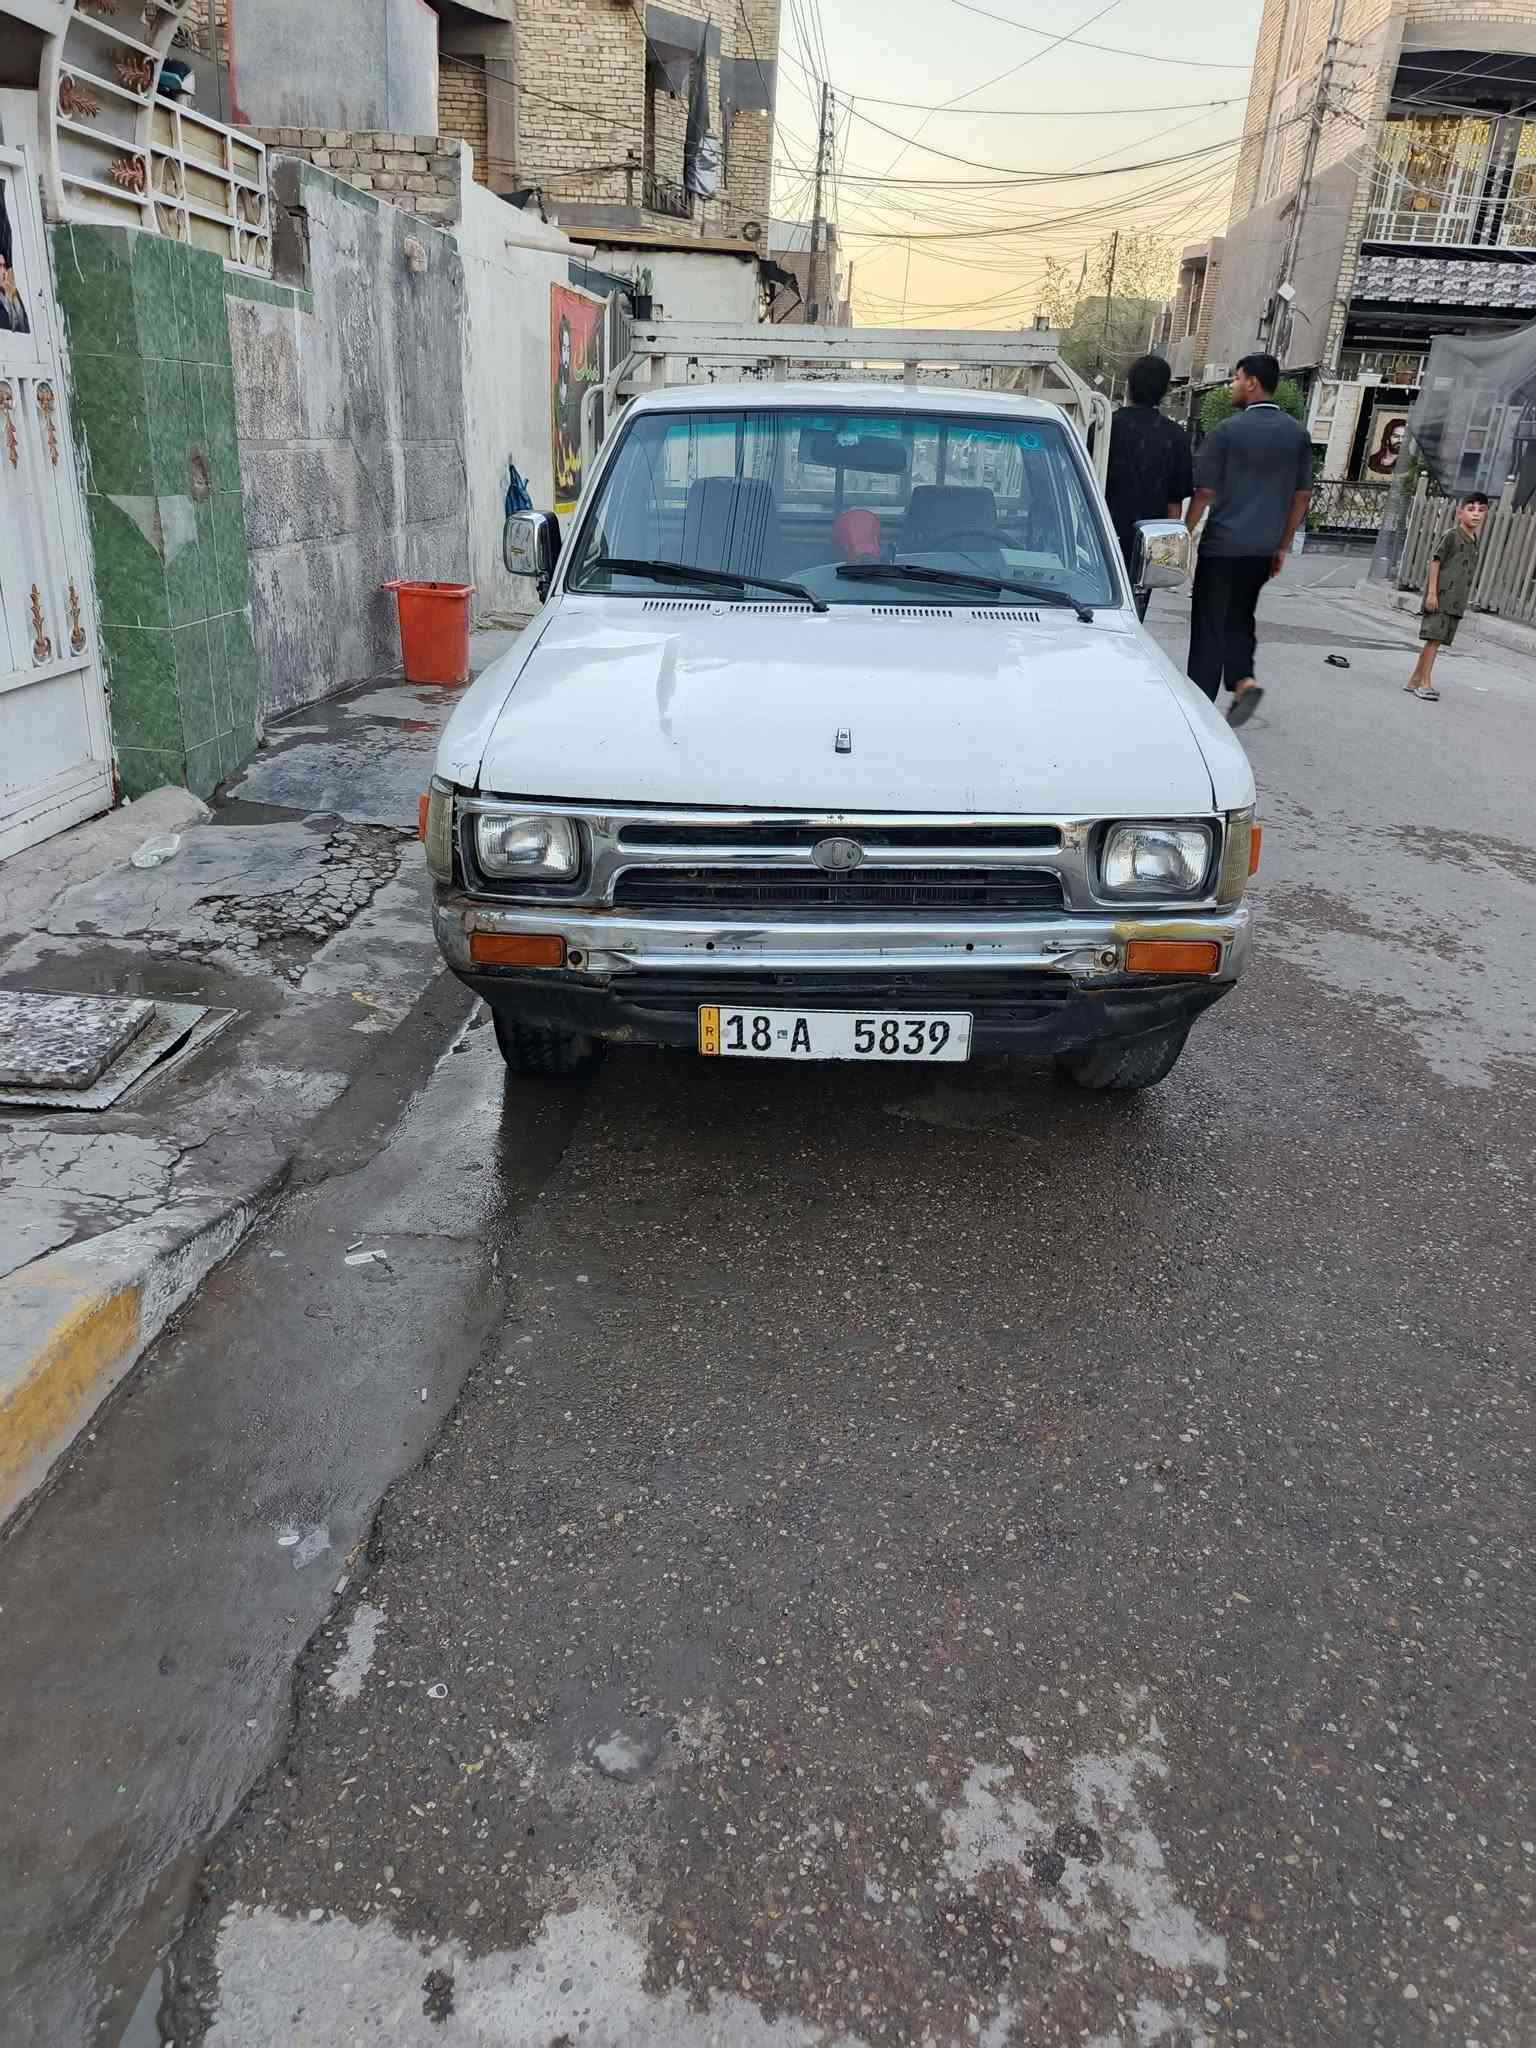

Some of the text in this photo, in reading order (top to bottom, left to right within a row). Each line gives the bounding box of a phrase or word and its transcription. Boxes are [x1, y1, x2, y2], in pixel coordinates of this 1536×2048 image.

[727, 1014, 951, 1055] 18 A 5839
